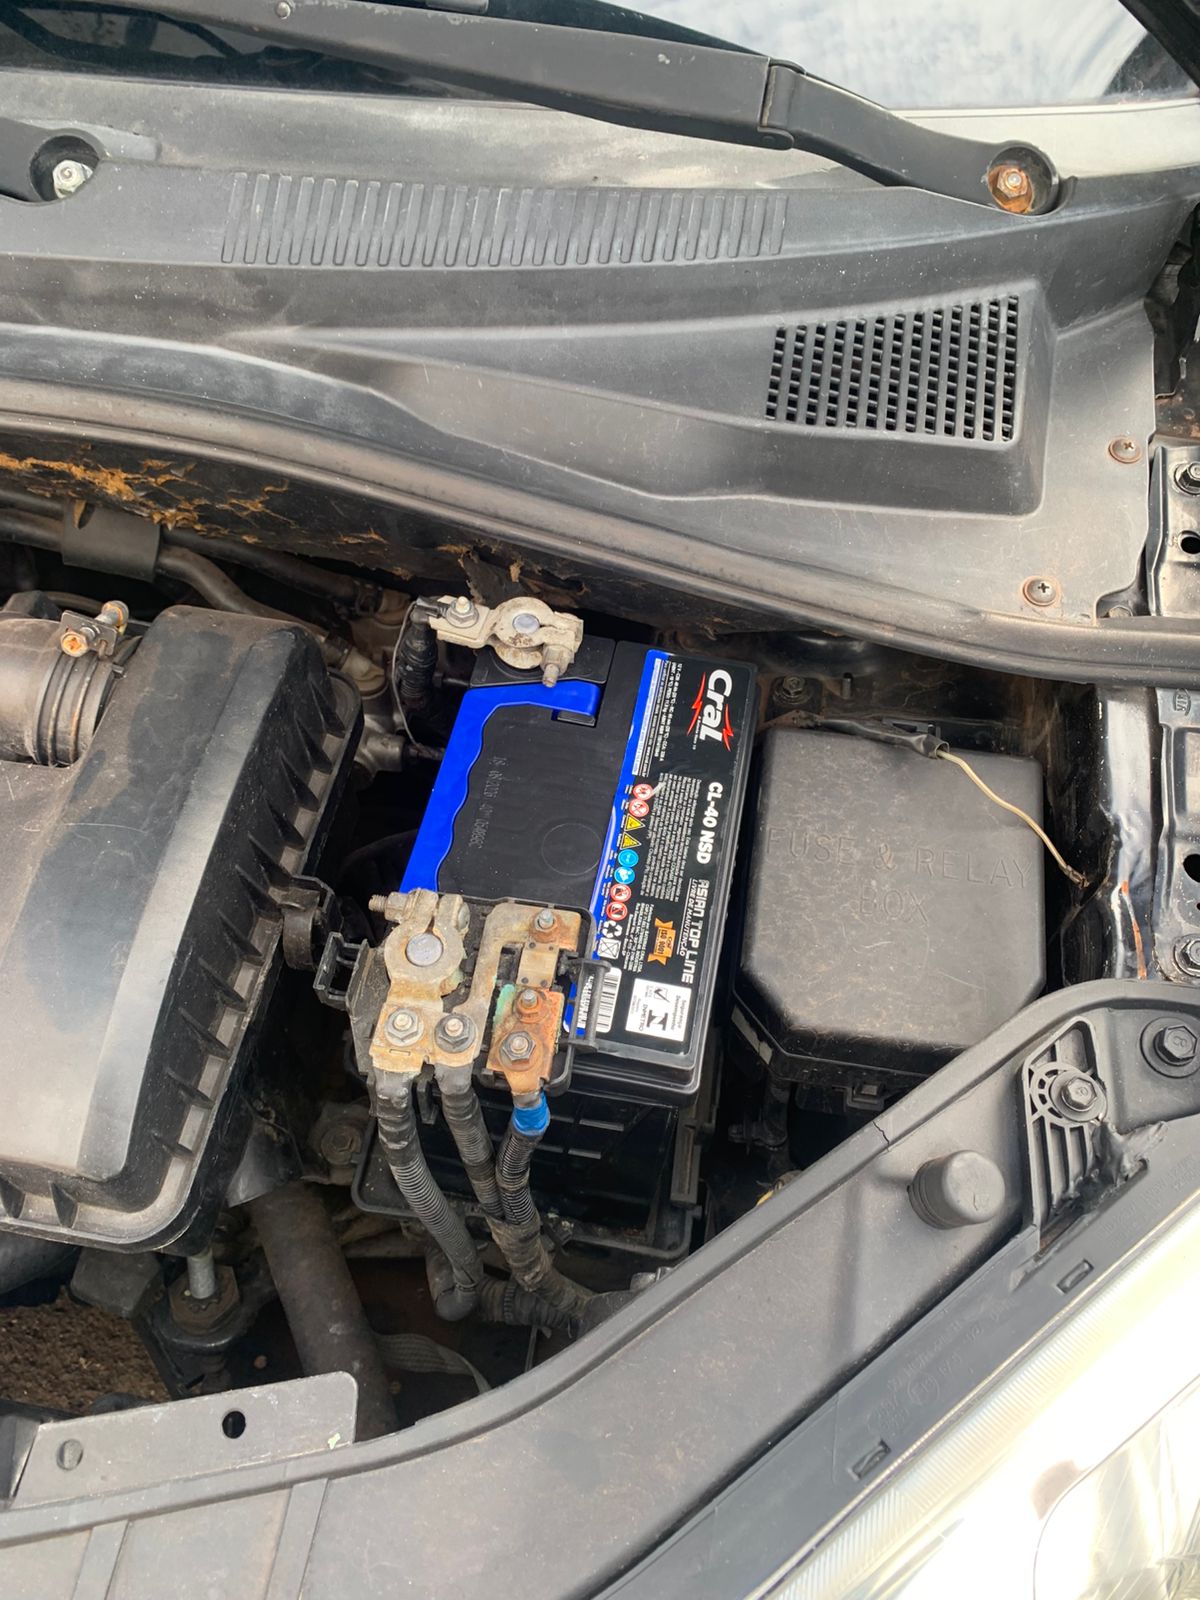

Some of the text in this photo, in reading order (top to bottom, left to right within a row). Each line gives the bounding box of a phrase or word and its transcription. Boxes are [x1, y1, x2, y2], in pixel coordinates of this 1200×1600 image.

[699, 669, 733, 741] Cral
[697, 782, 723, 864] CL-40 NSD
[766, 826, 1032, 889] FUSE & RELAY
[687, 898, 694, 907] DE
[859, 887, 929, 926] BOX
[656, 940, 665, 955] 9001
[680, 908, 693, 957] MANUTENÇÃO
[681, 879, 709, 984] ASIAN TOP LINE
[638, 1003, 648, 1031] INMETRO
